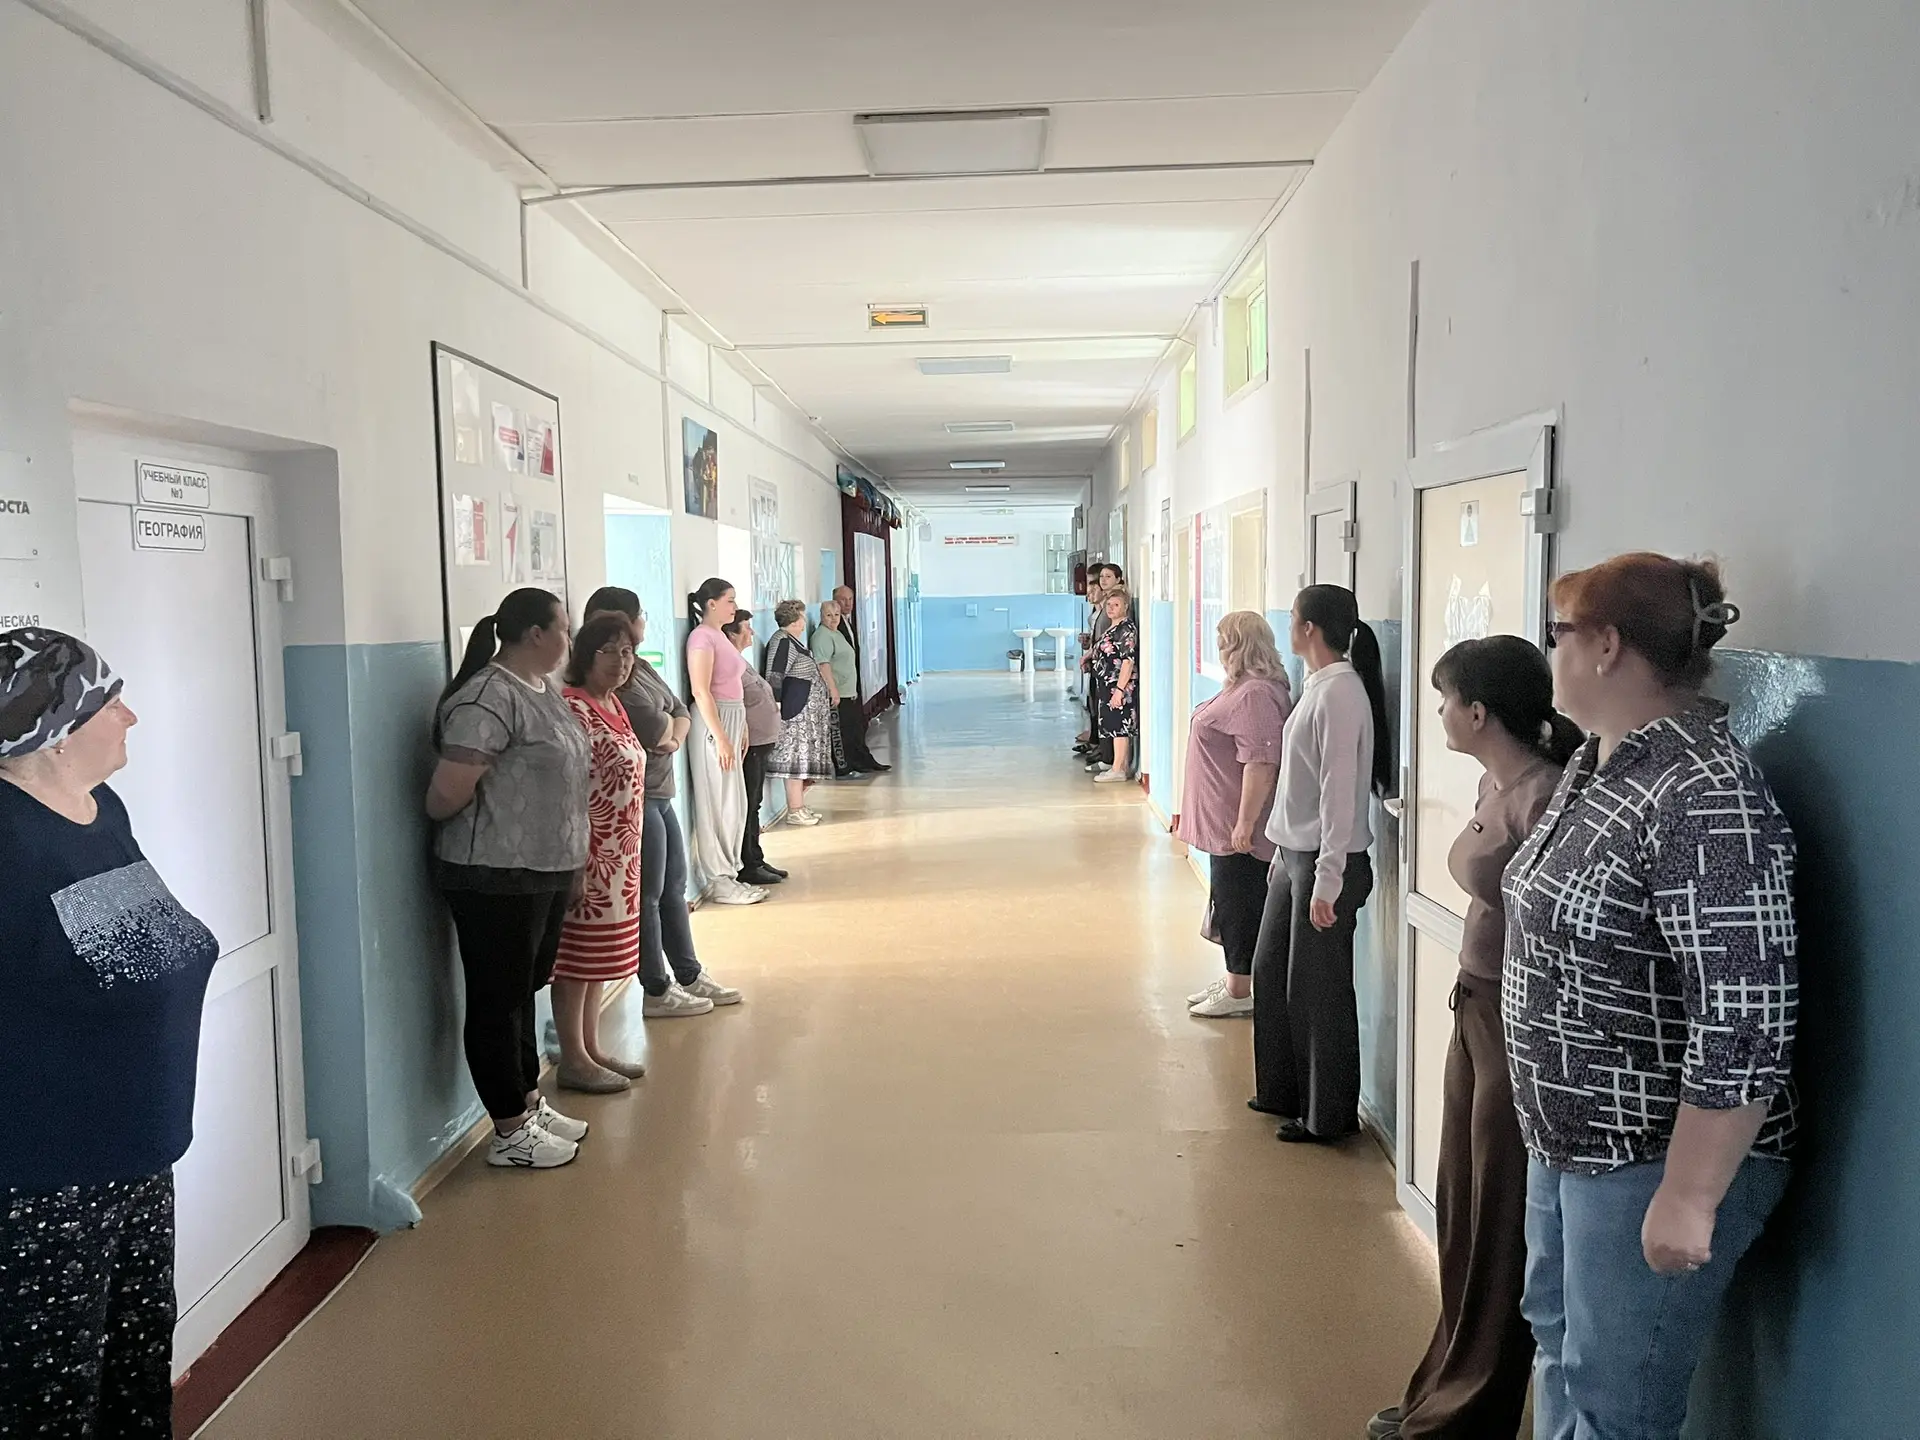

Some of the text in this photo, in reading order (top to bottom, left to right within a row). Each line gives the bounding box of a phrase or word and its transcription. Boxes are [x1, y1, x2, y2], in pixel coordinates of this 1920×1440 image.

[143, 469, 207, 489] УЧЕБНЫЙ КЛАСС
[138, 520, 203, 540] ГЕОГРАФИЯ
